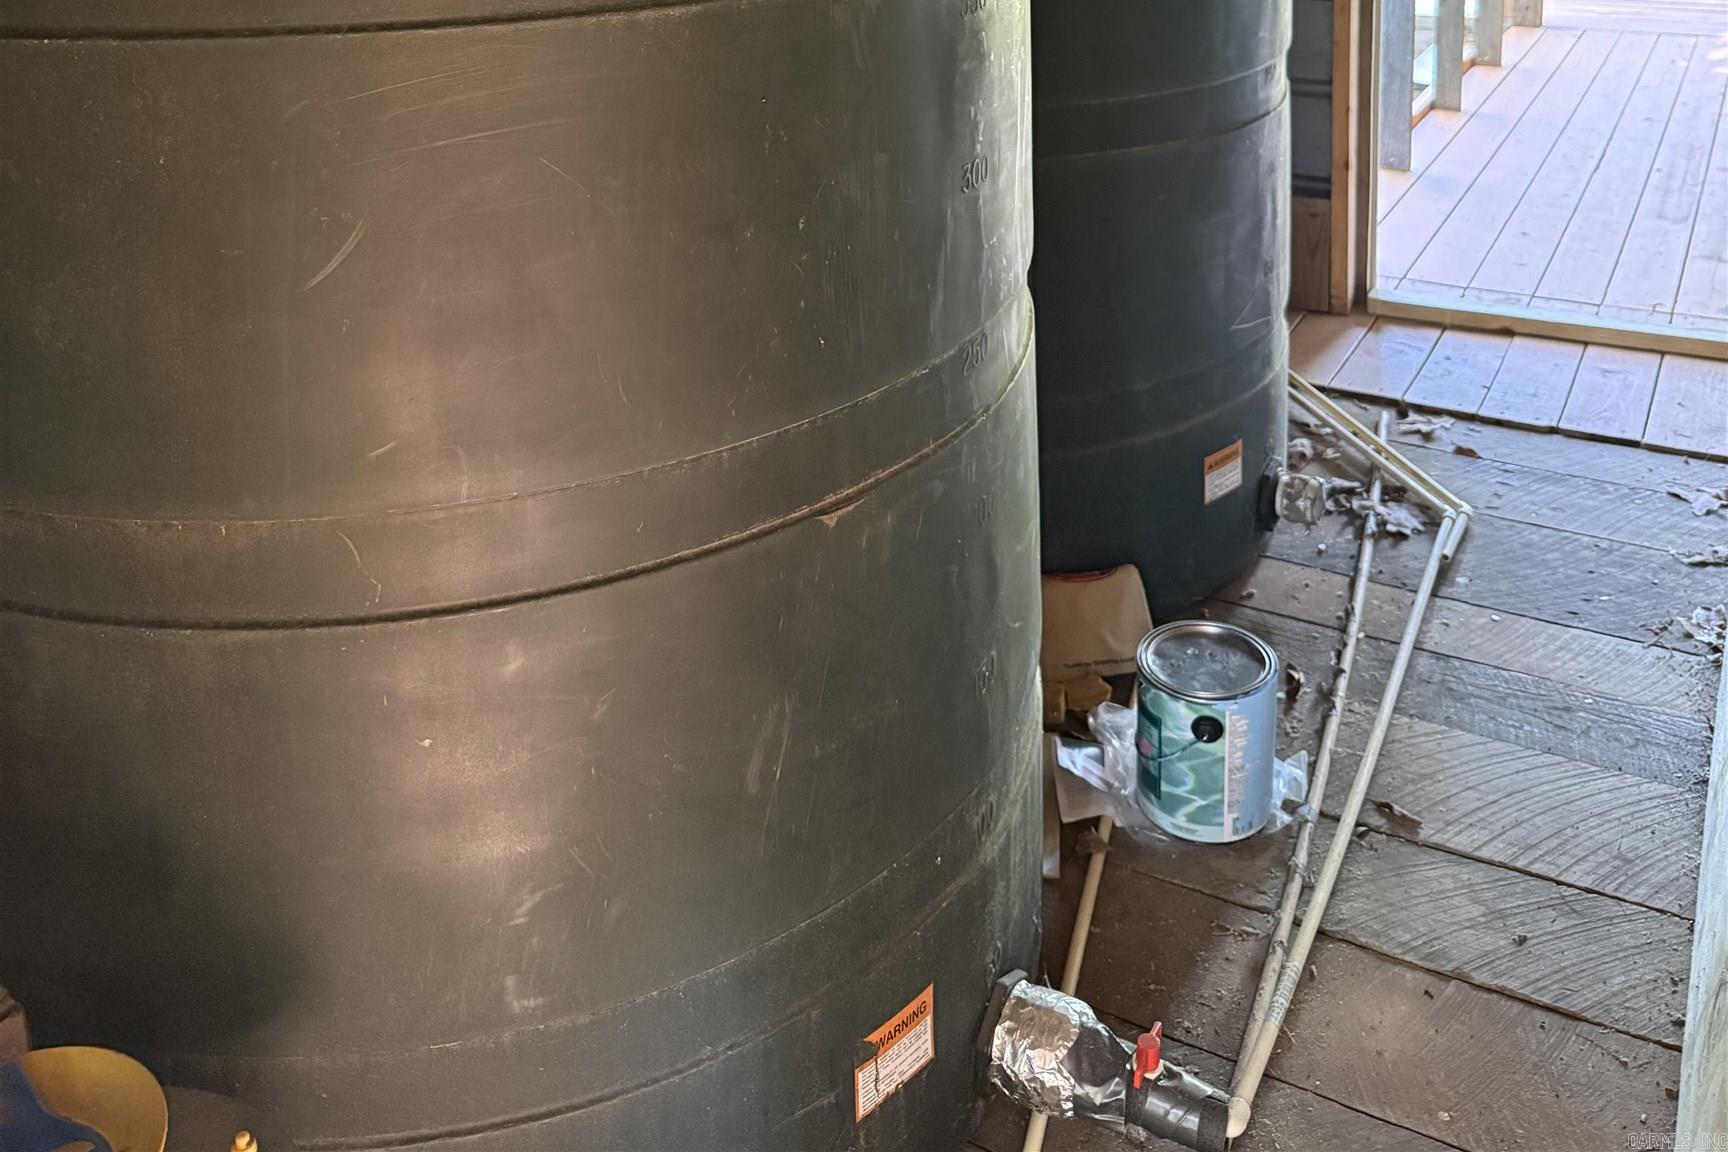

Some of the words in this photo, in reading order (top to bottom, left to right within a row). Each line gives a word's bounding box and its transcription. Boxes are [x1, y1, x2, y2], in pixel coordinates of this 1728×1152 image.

[961, 156, 988, 195] 300
[961, 332, 988, 377] 250
[874, 1000, 928, 1049] WARNING
